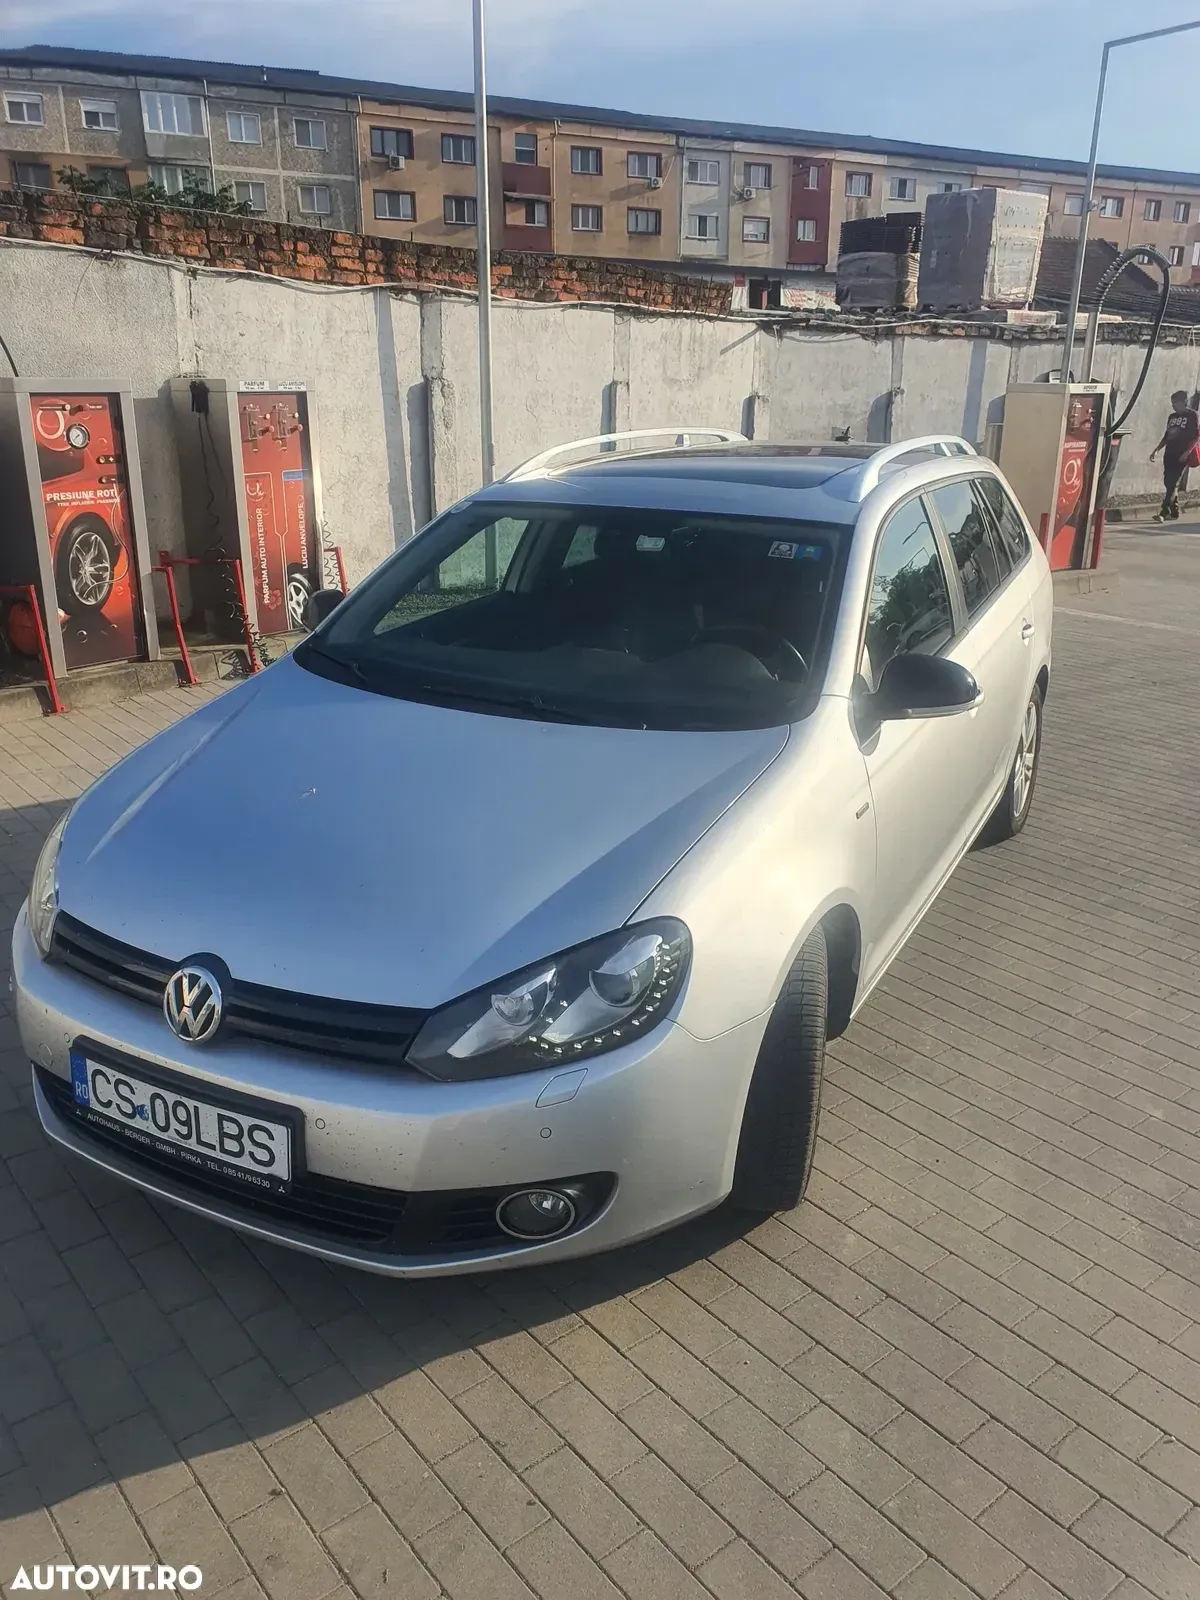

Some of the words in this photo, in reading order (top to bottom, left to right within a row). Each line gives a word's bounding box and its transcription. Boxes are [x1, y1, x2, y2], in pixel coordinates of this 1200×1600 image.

[46, 490, 94, 501] PRESIUNE
[256, 508, 265, 546] INTERIOR
[298, 503, 307, 545] ANVELOPE
[260, 547, 268, 570] AUTO
[262, 570, 270, 604] PARFUM
[75, 1081, 89, 1099] RO
[87, 1113, 121, 1132] AUTOHAUS
[125, 1129, 150, 1145] BERGER
[156, 1142, 176, 1154] GMBH
